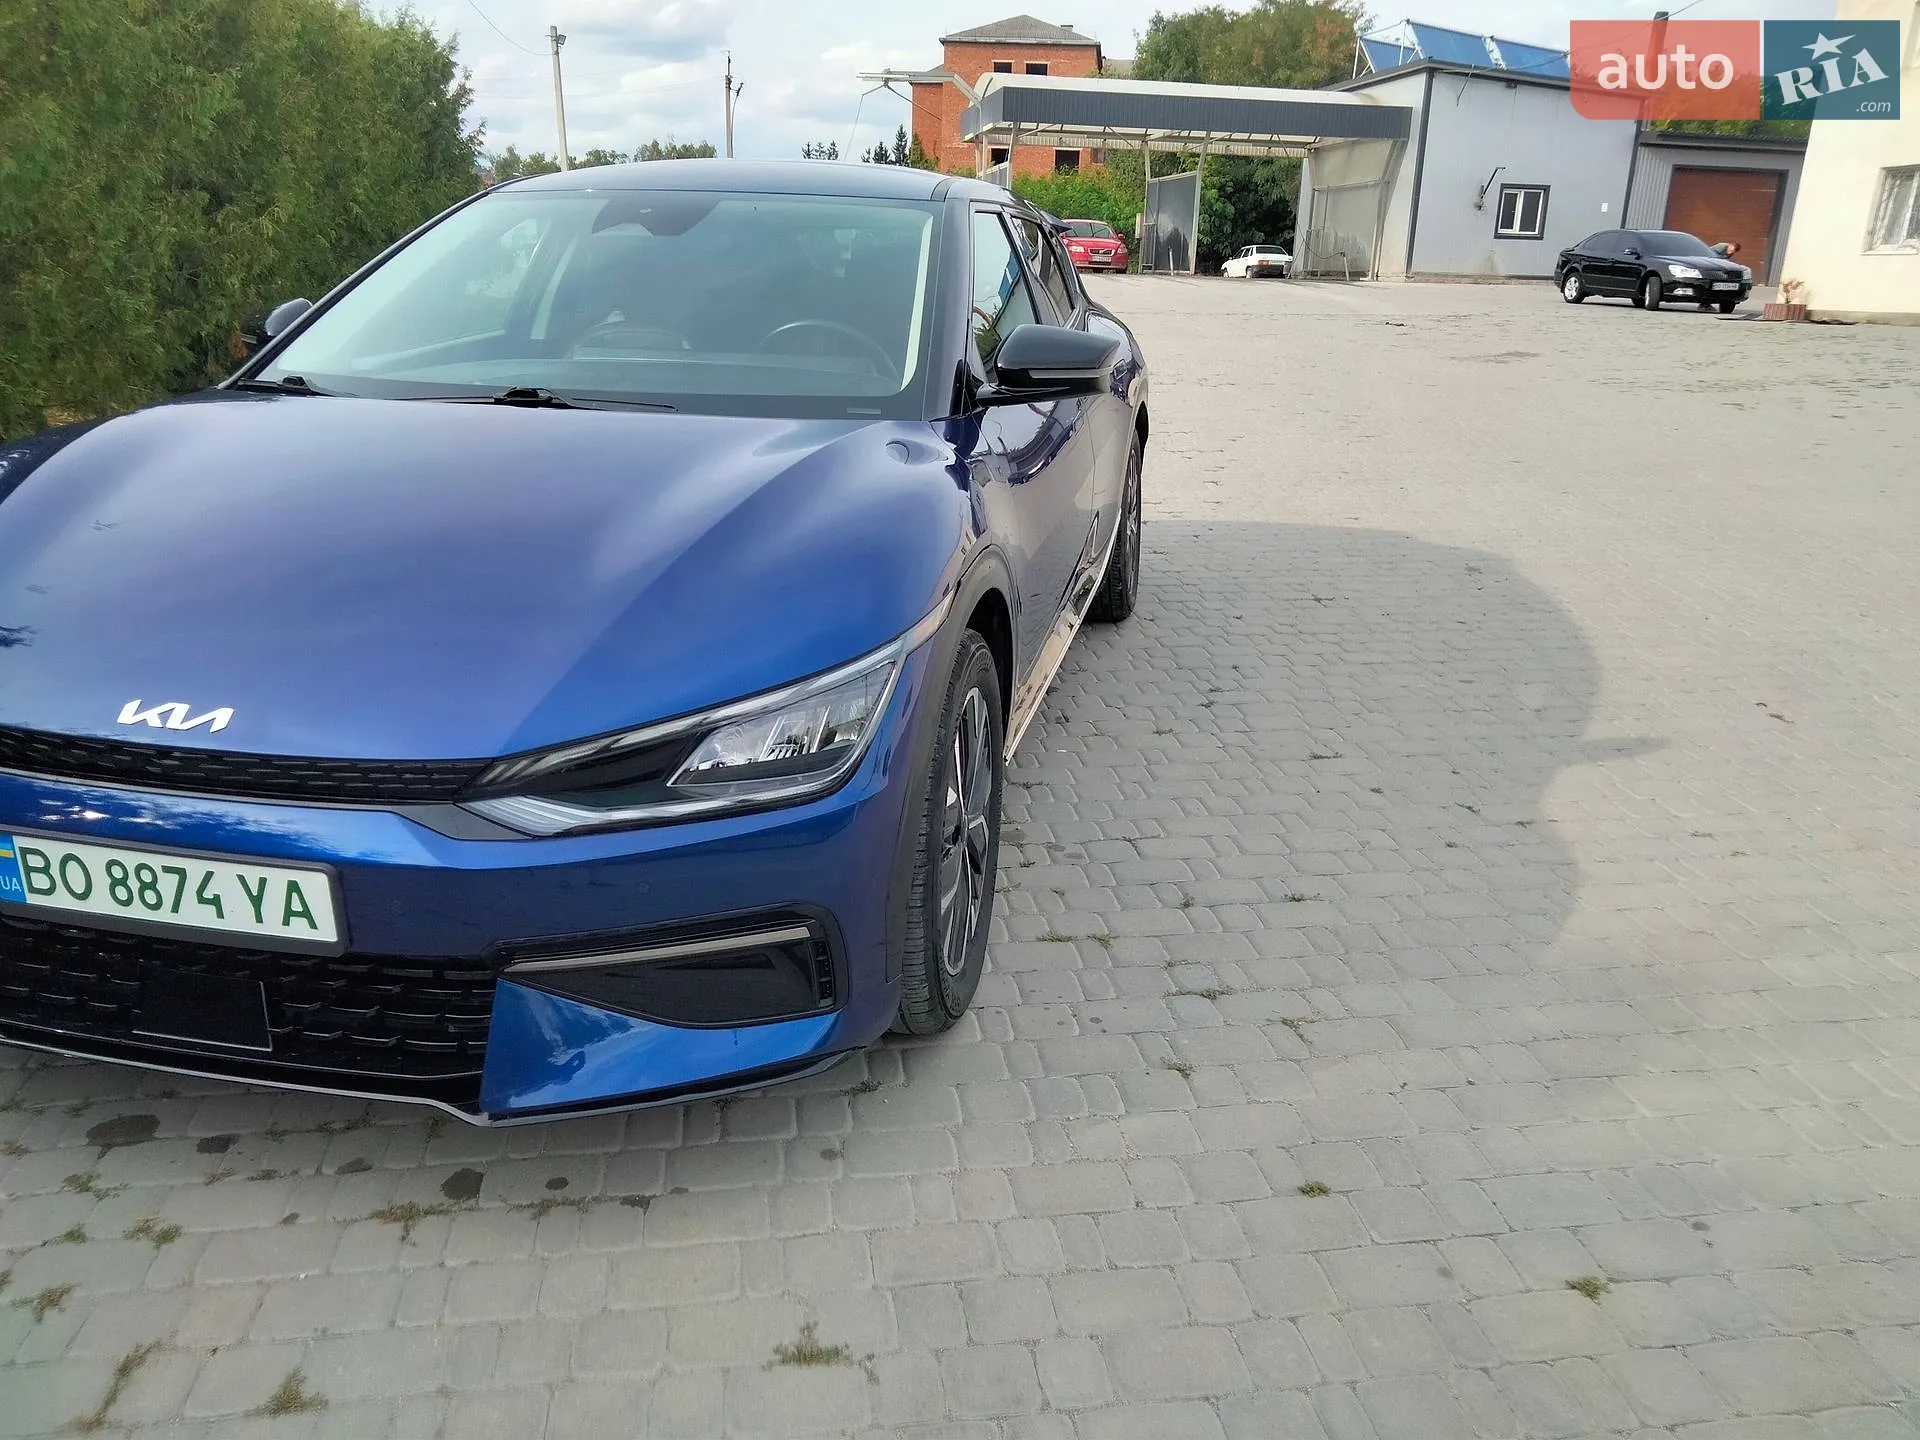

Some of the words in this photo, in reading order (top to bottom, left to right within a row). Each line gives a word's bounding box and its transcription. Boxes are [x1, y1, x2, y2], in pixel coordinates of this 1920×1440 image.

[0, 875, 22, 893] UA
[18, 845, 93, 902] BO
[105, 858, 225, 920] 8874
[235, 873, 319, 930] YA
